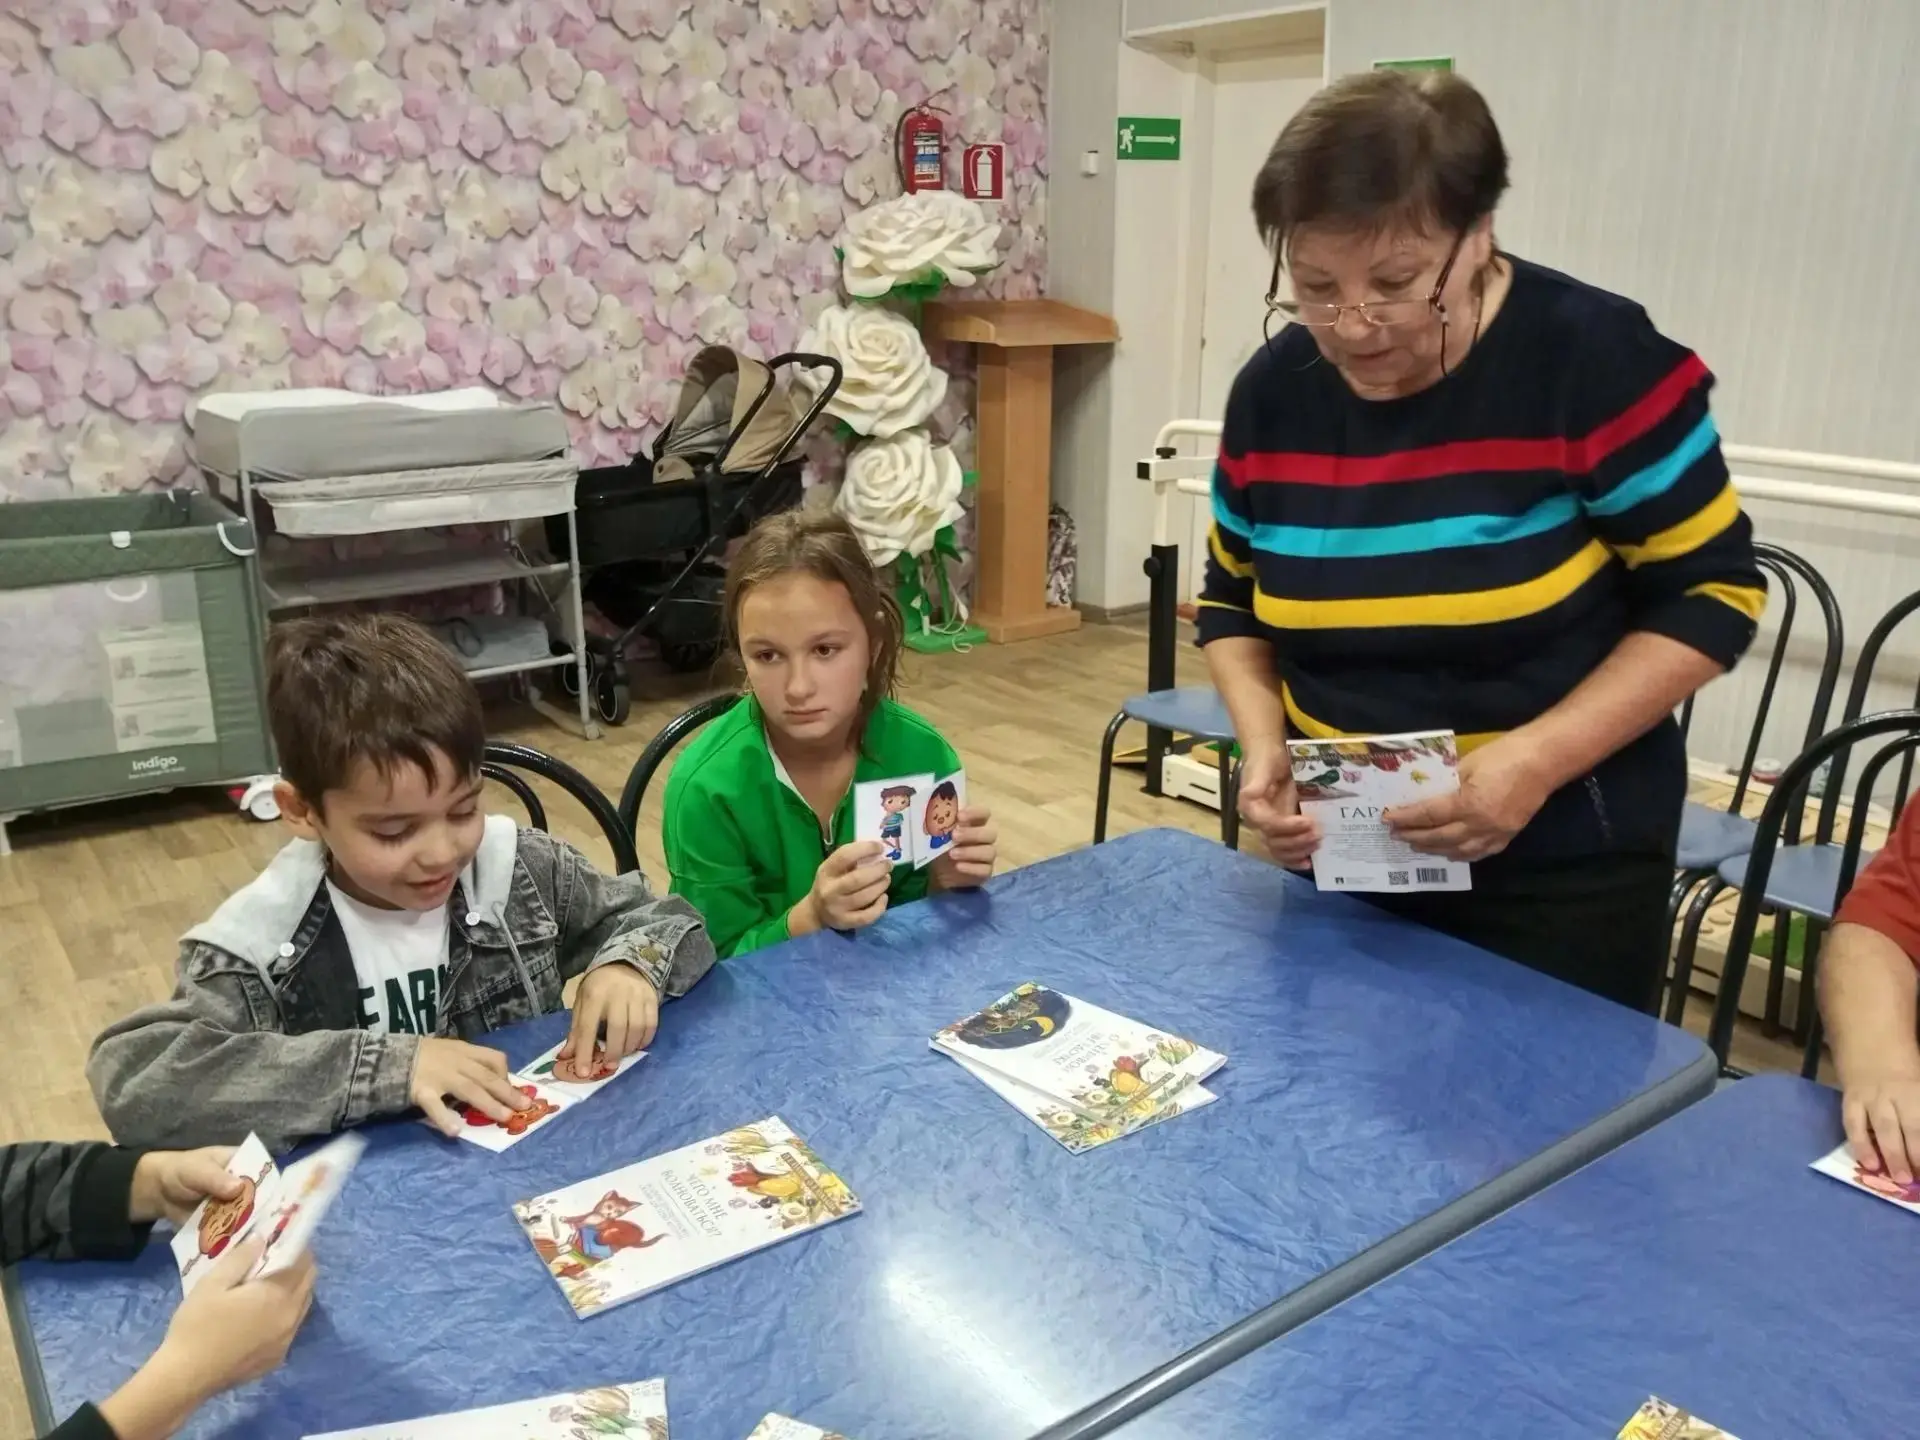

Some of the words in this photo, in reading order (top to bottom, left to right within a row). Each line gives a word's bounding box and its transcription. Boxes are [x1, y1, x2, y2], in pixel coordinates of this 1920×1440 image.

[132, 755, 178, 771] Indigo
[660, 1168, 723, 1239] ВОЛНОВАТЬСЯ?
[684, 1171, 712, 1198] ЧЕГО
[702, 1196, 729, 1220] МНЕ
